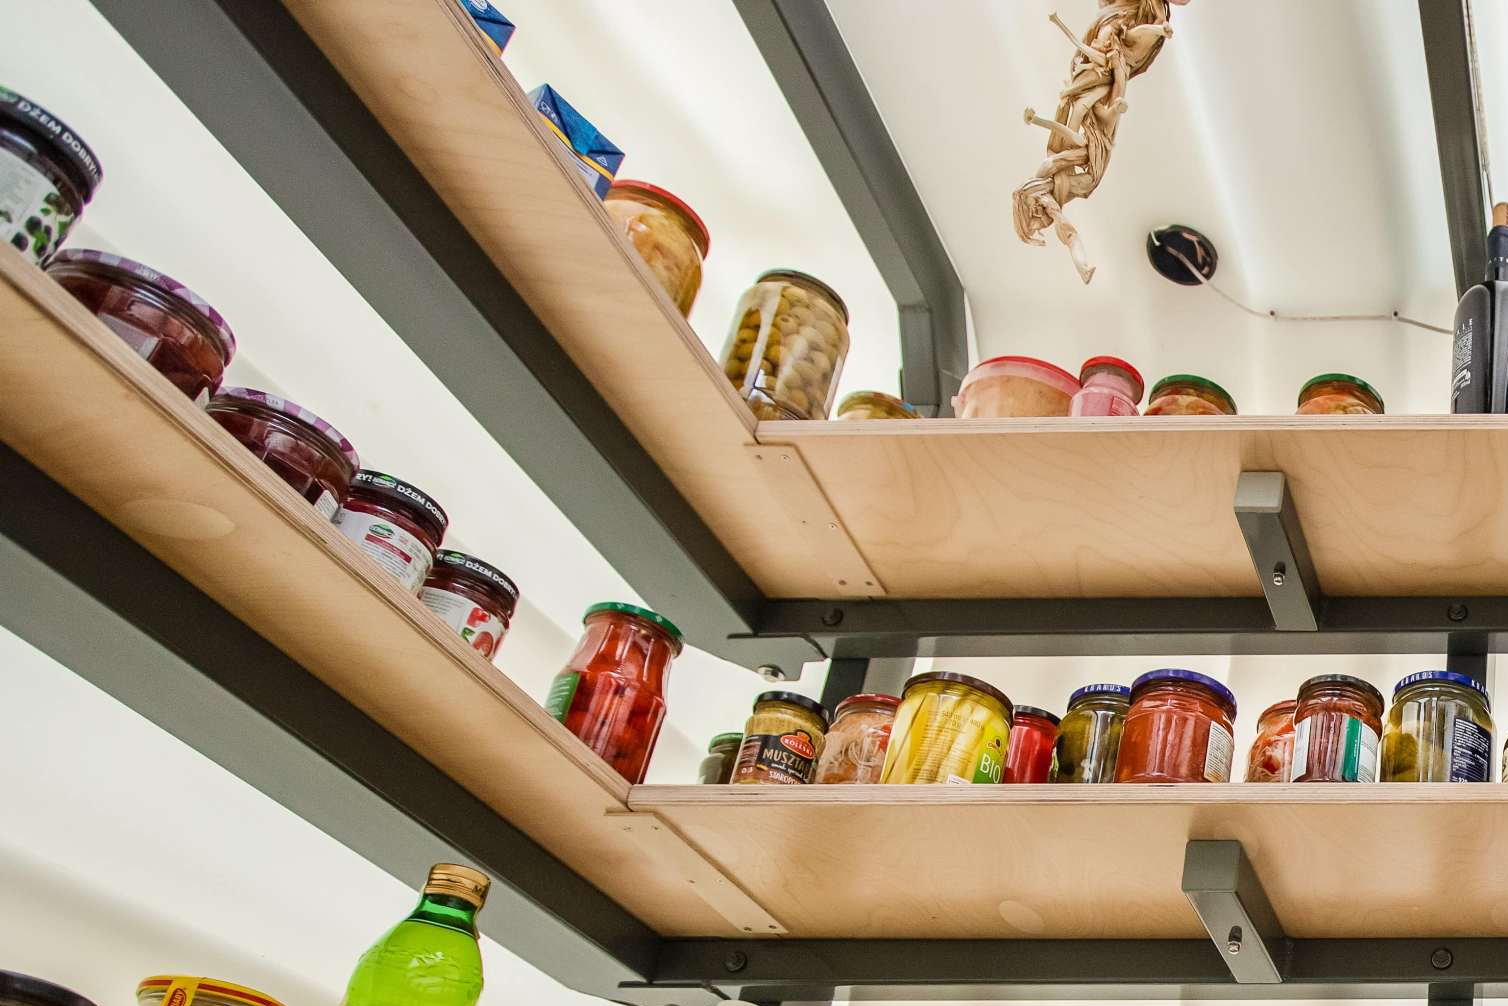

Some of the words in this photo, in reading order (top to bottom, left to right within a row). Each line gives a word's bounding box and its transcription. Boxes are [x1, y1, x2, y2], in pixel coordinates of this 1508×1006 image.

[17, 100, 62, 135] DŻEM
[397, 484, 425, 505] DŻEM
[465, 560, 492, 578] DŻEM
[980, 753, 1001, 783] BIO
